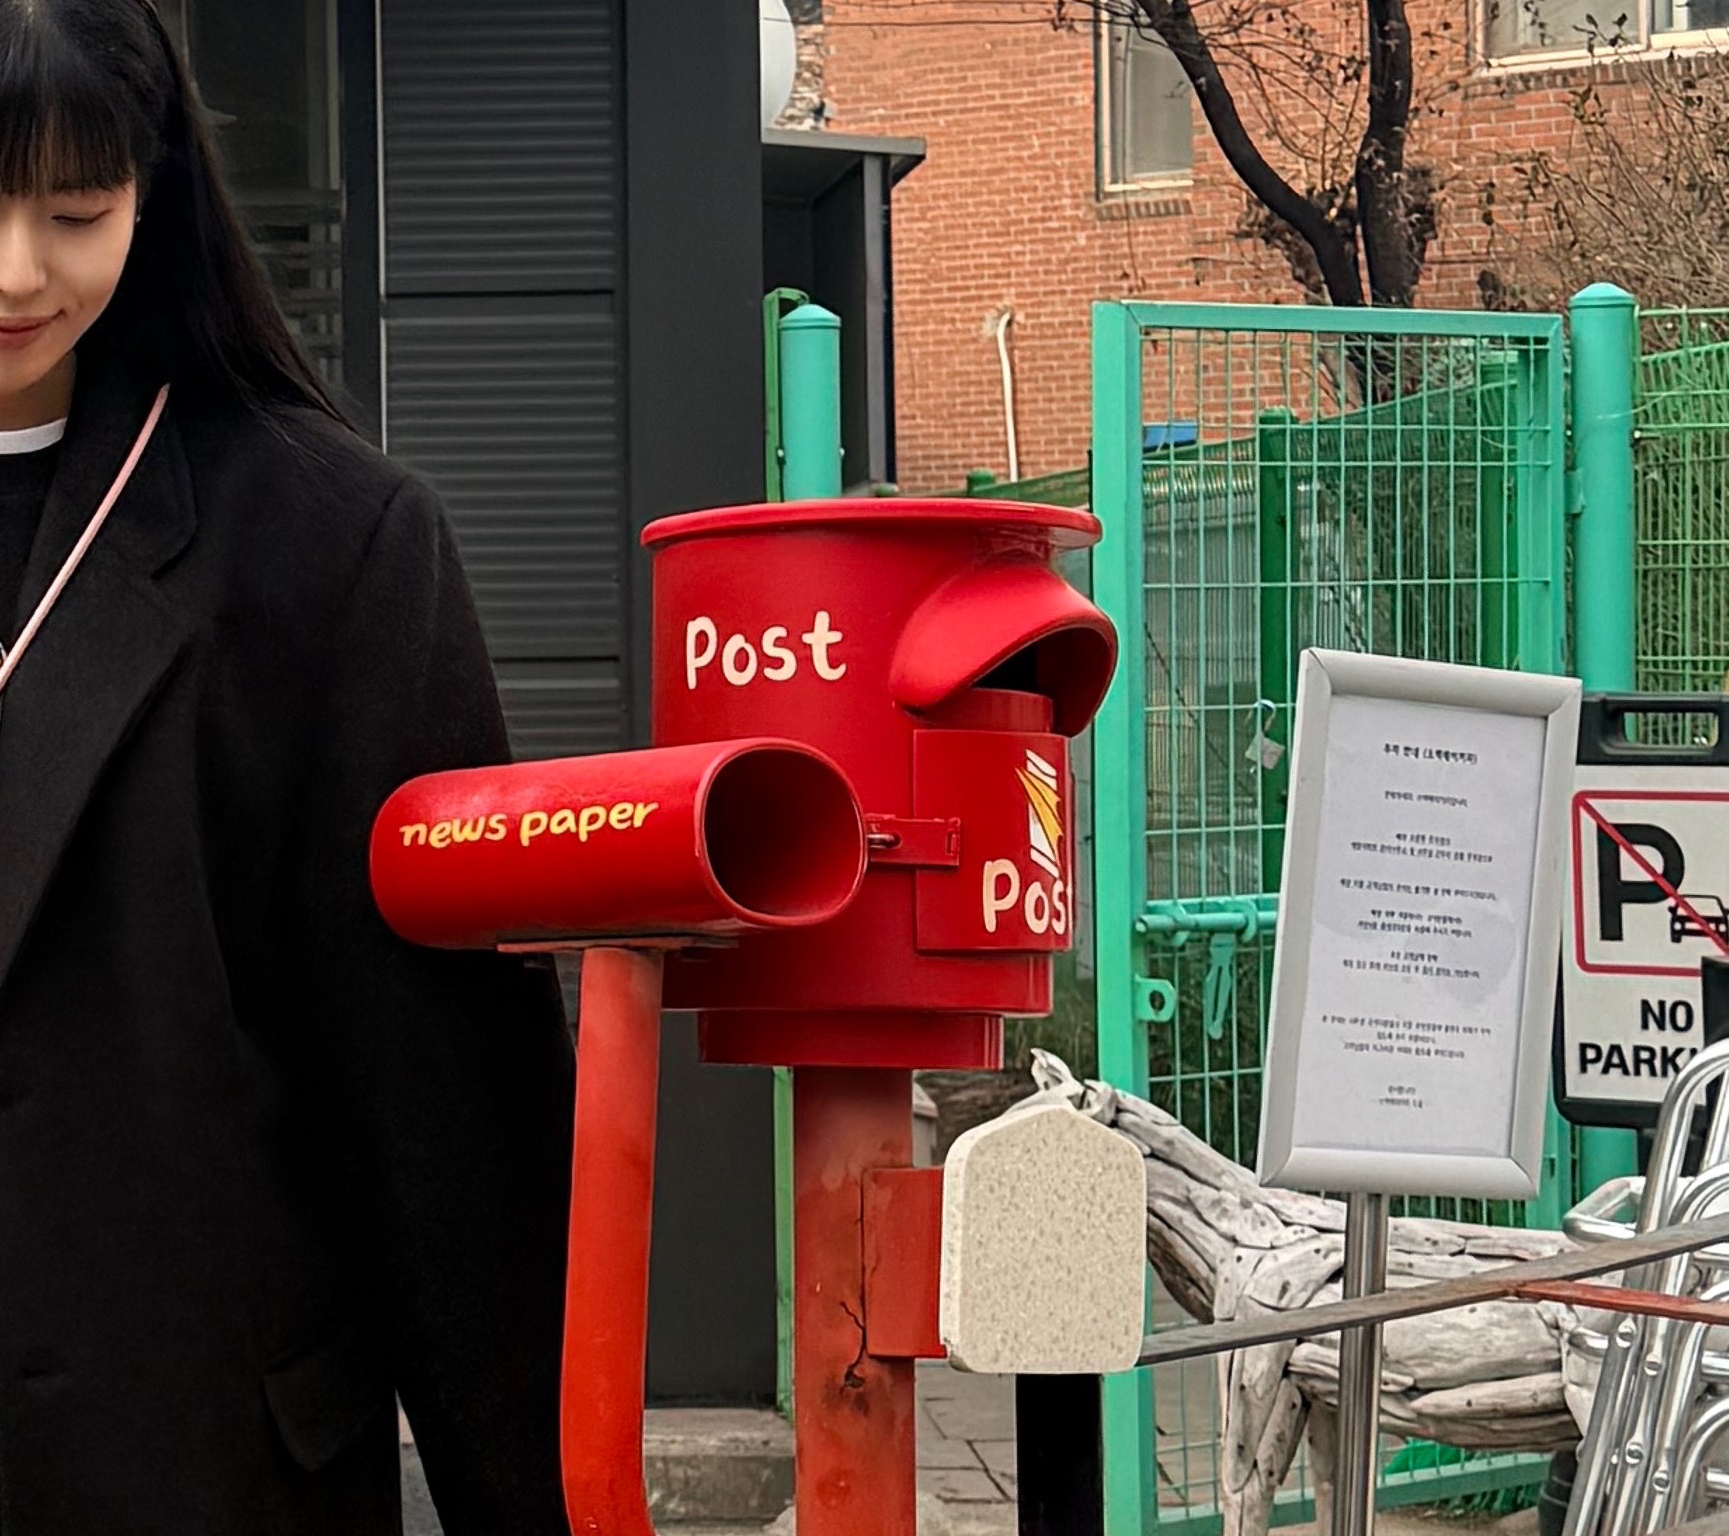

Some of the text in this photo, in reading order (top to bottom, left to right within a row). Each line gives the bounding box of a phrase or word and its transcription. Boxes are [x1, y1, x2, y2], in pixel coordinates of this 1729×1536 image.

[685, 610, 847, 691] Post
[400, 800, 660, 849] news paper
[982, 858, 1072, 935] Pos
[1639, 998, 1695, 1033] NO
